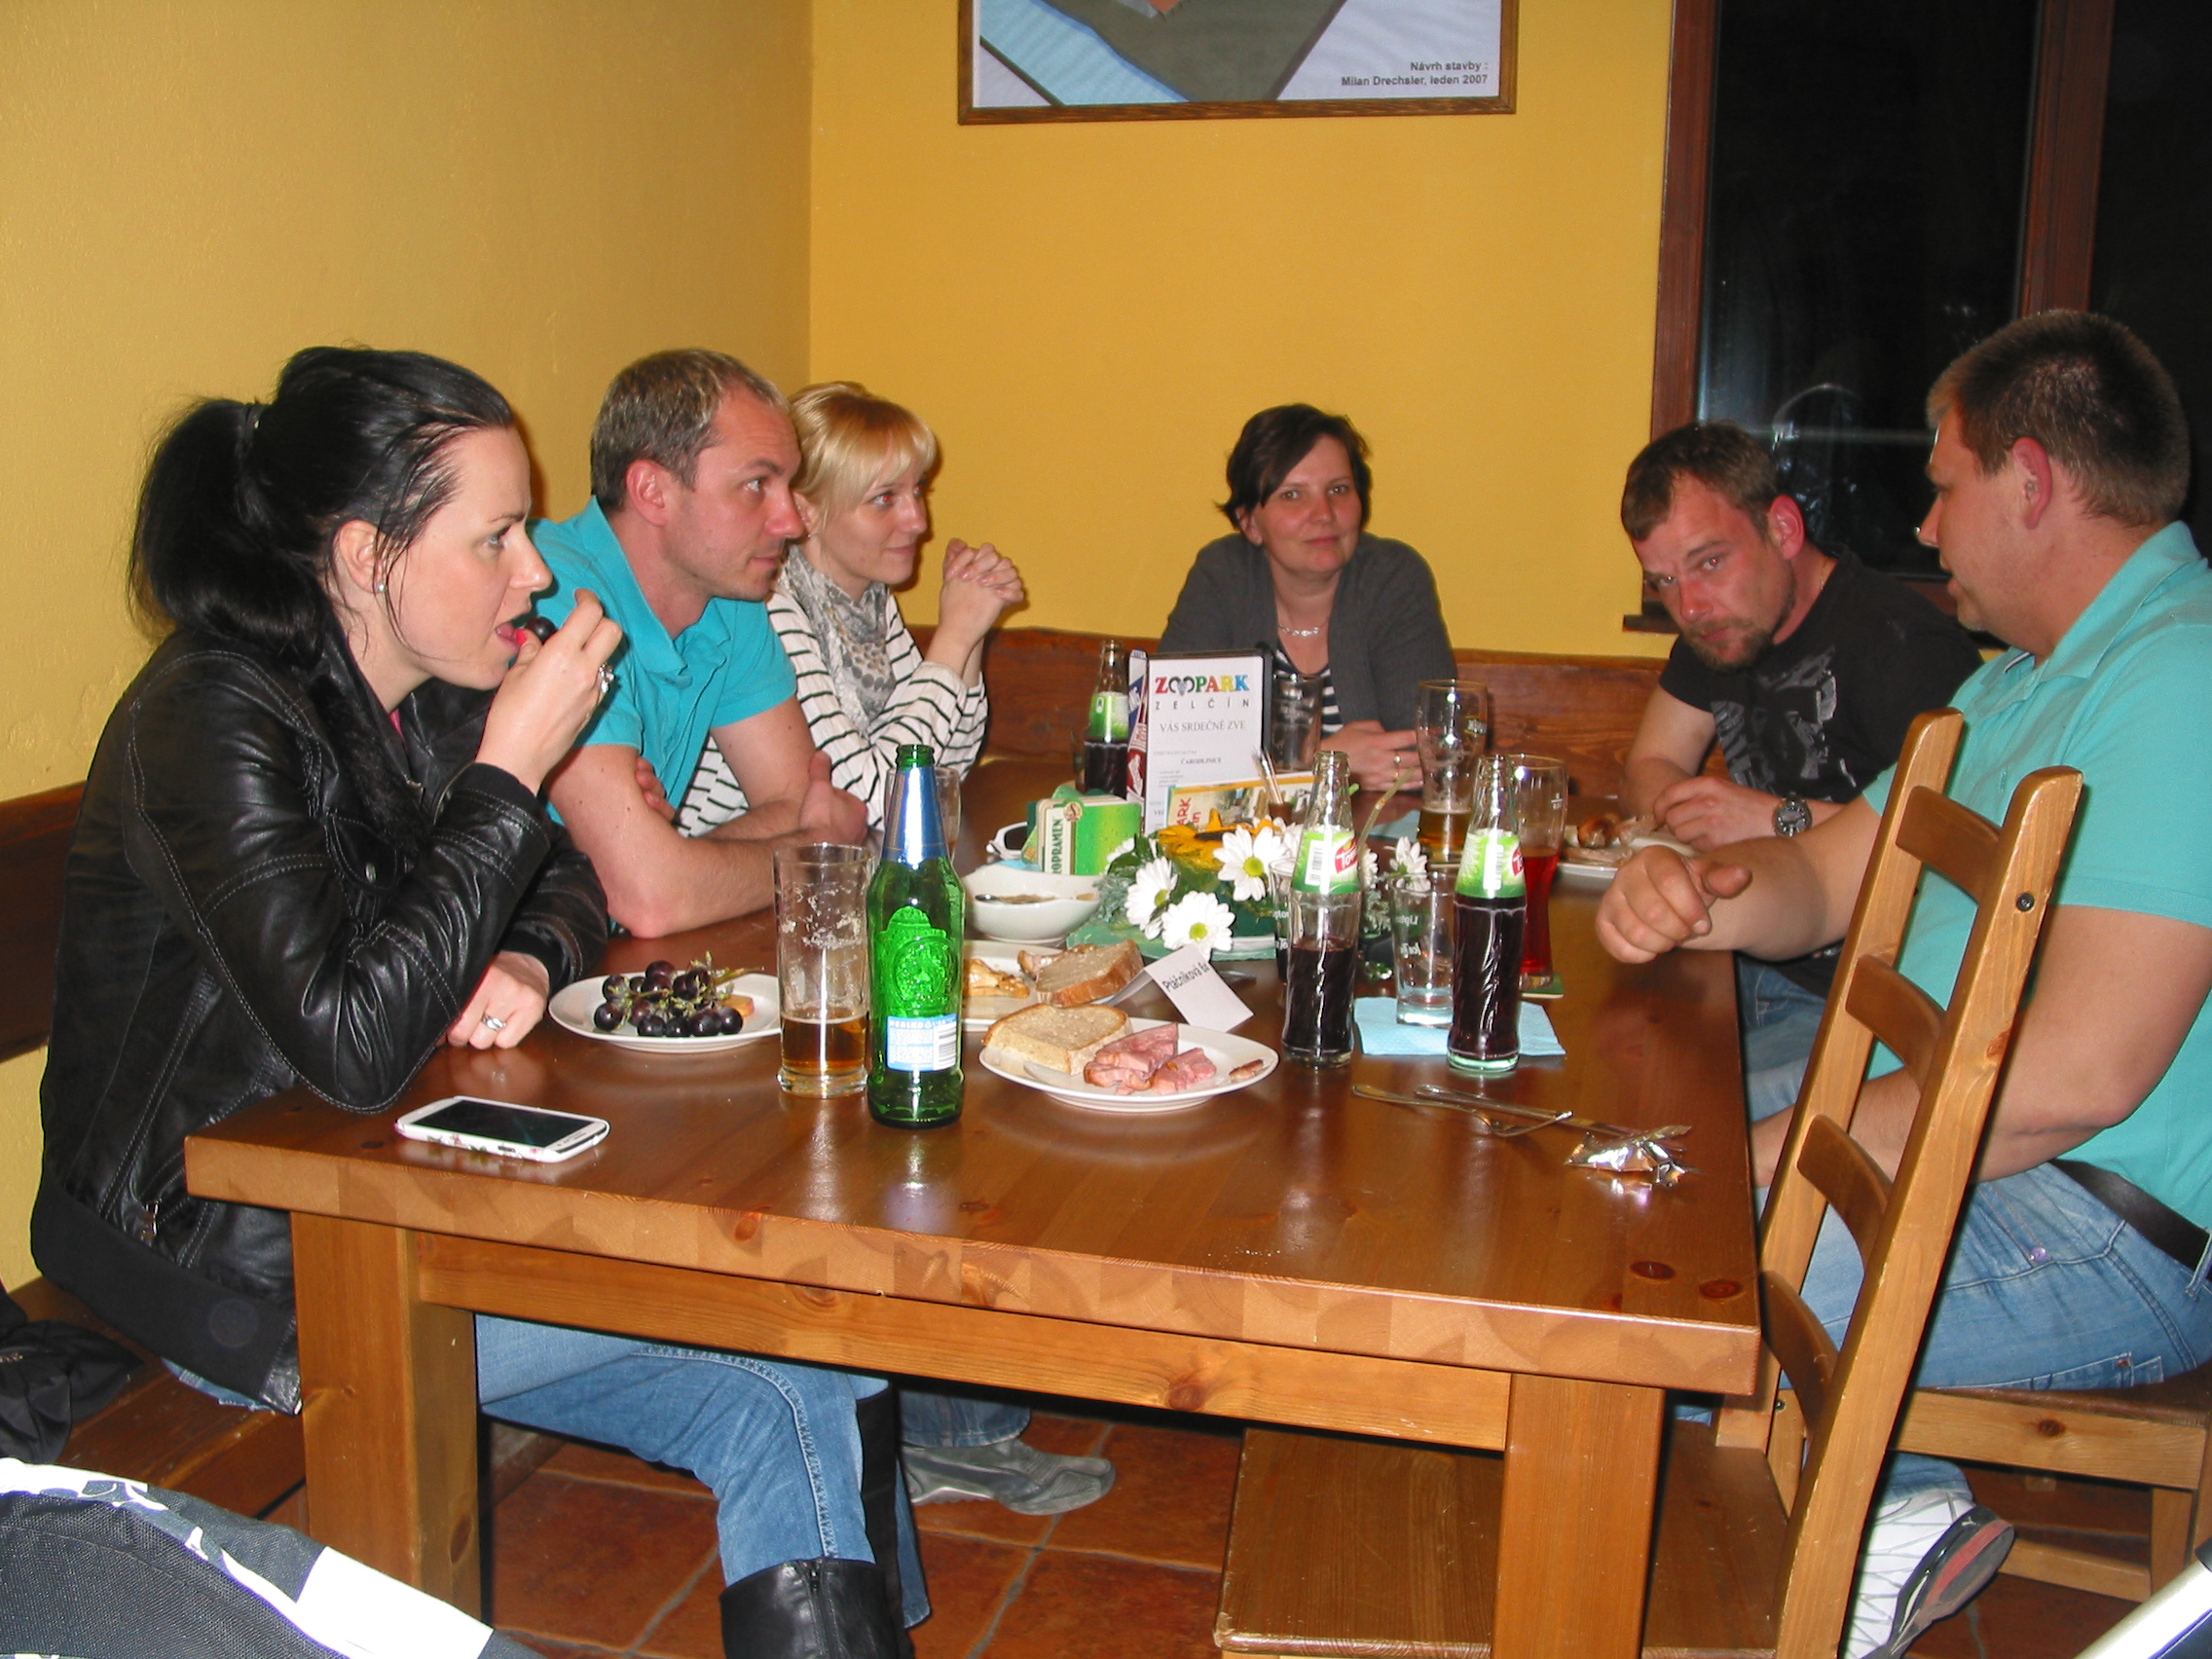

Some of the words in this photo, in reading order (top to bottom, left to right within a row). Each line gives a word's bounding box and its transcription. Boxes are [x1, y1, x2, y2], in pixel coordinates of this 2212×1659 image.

[1411, 61, 1442, 71] Návrh
[1445, 61, 1482, 73] stavby
[1342, 76, 1370, 86] Milan
[1373, 75, 1426, 87] Drechsler,
[1430, 75, 1459, 85] leden
[1462, 74, 1488, 85] 2007
[1155, 675, 1250, 696] ZOOPARK
[1160, 720, 1180, 733] VÁS
[1227, 720, 1246, 730] ZVE
